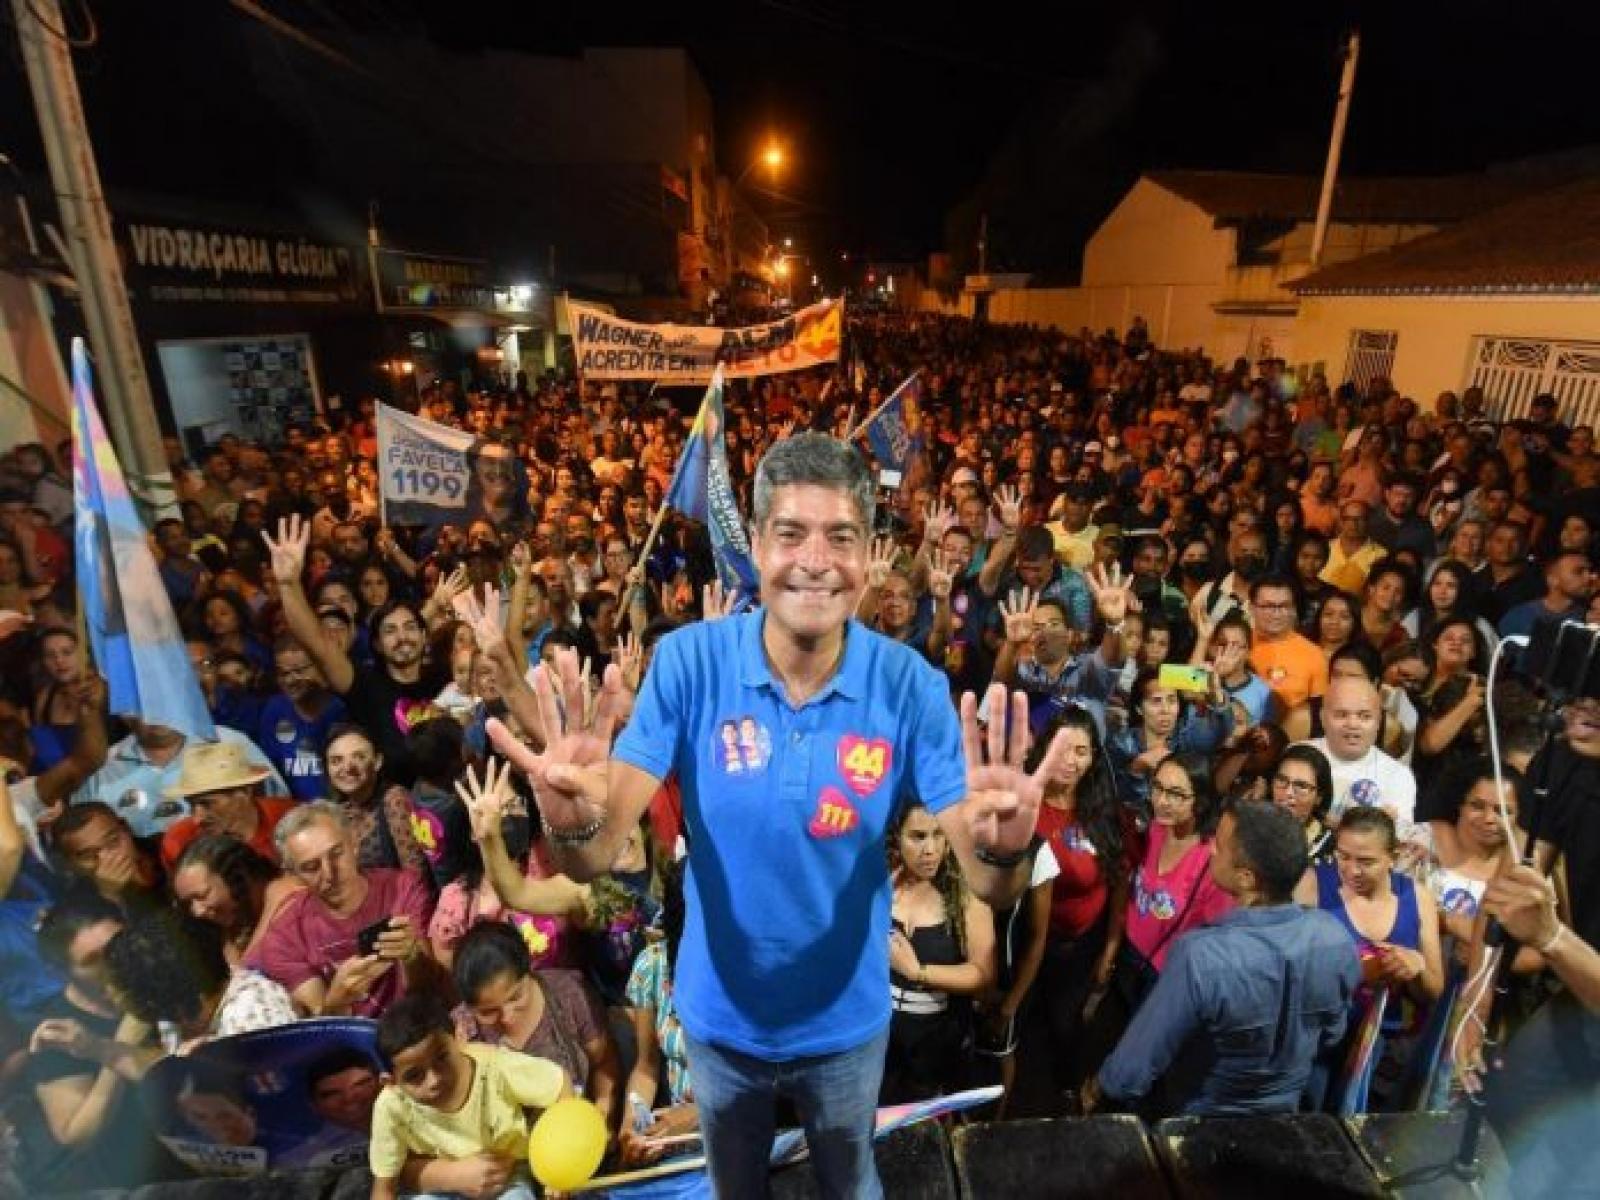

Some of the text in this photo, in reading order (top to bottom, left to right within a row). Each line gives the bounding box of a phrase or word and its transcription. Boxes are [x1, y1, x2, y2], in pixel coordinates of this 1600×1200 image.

[128, 224, 271, 280] VIDRAÇARIA
[578, 313, 662, 351] WAGNER
[582, 349, 664, 370] ACREDITA
[388, 447, 465, 473] FAVELA
[392, 467, 463, 498] 1199
[844, 743, 885, 777] 44
